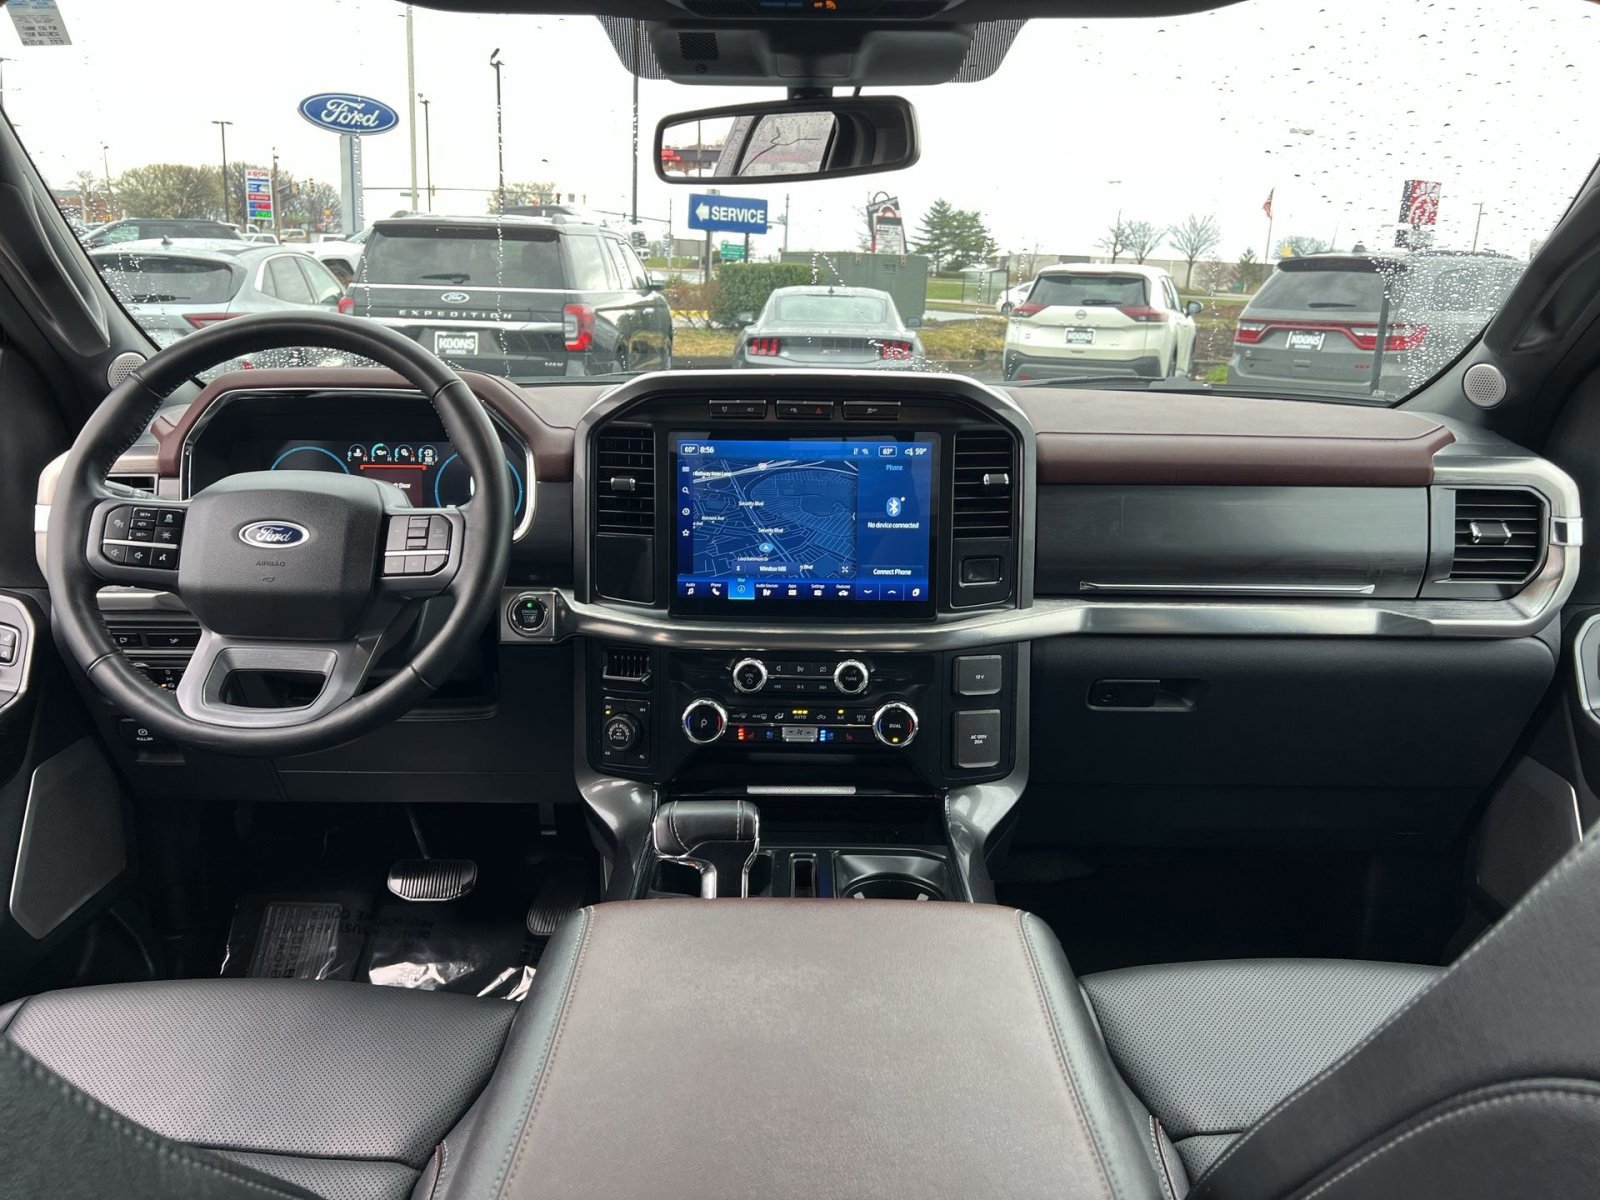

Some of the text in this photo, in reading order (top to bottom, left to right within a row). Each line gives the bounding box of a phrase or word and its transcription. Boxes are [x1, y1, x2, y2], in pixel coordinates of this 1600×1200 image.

[320, 98, 381, 127] Ford
[711, 206, 766, 224] SERVICE
[398, 309, 513, 320] EXPEDITION
[438, 337, 476, 350] KOONS
[1290, 334, 1321, 345] KOONS
[699, 446, 715, 454] 8:56
[256, 526, 293, 543] Ford
[872, 568, 912, 576] Connect Phone
